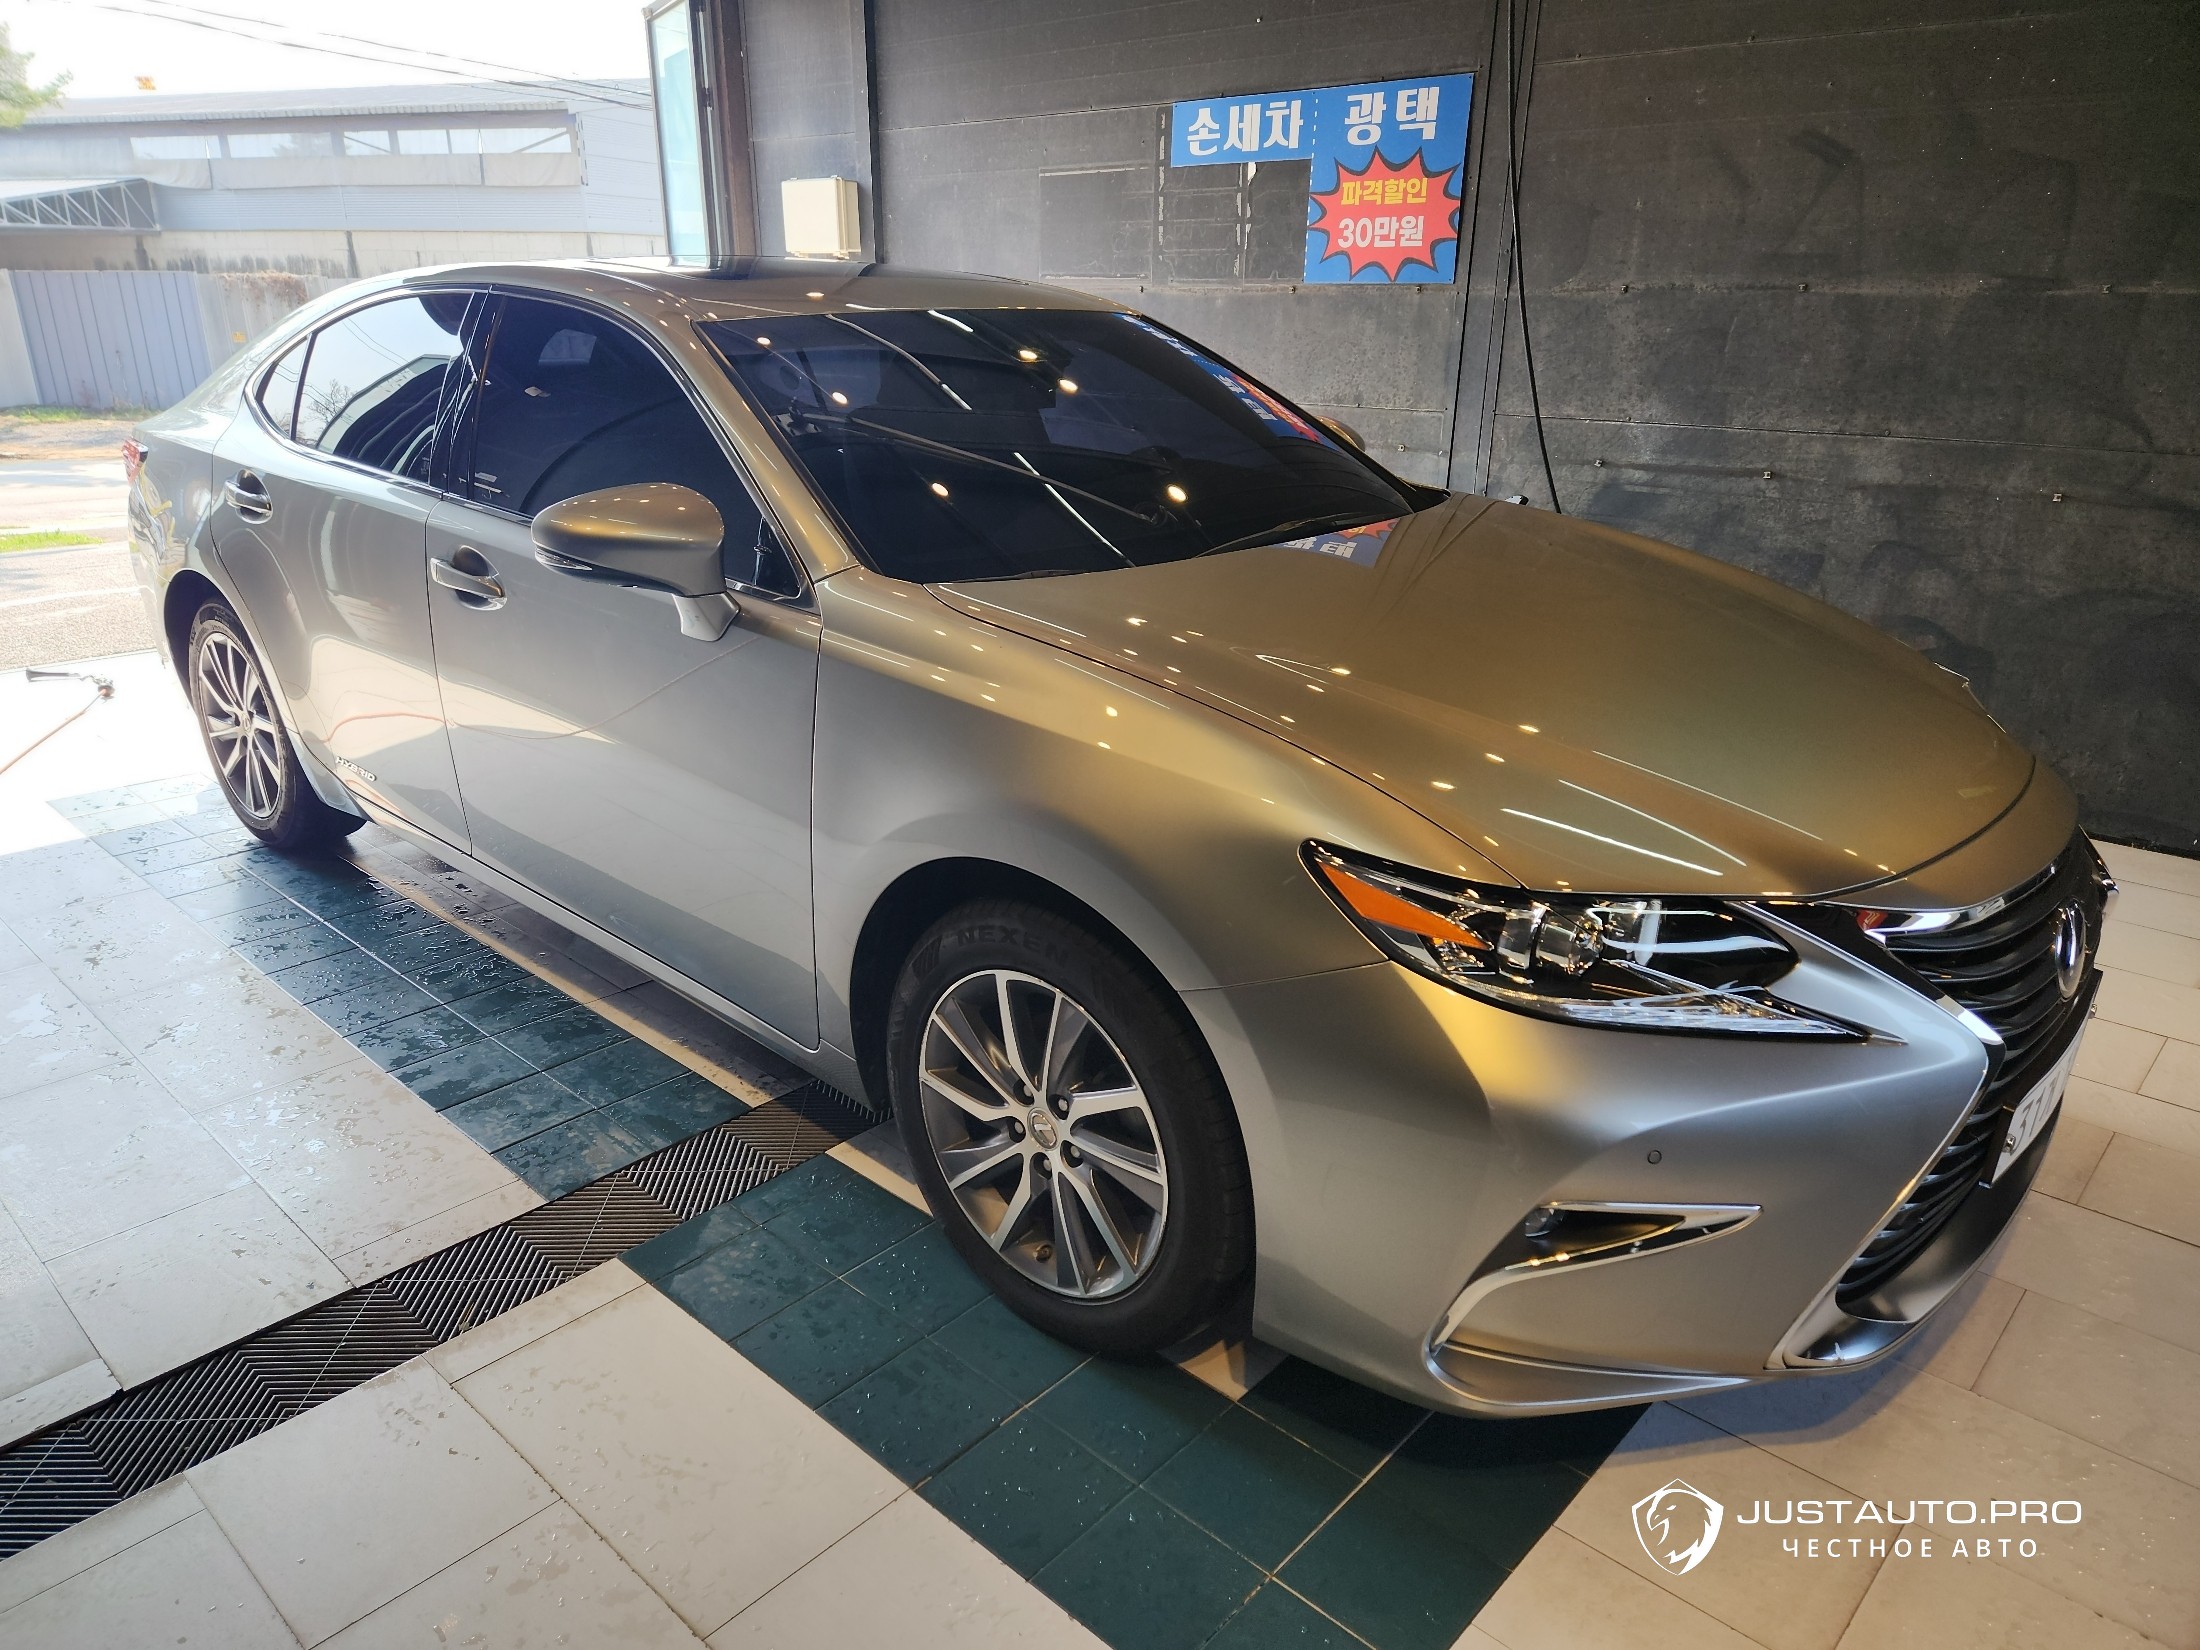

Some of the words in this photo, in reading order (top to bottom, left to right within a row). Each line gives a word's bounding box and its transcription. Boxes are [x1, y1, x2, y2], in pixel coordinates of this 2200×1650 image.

[1187, 100, 1304, 156] 손세차
[1344, 86, 1440, 146] 광택
[1341, 178, 1428, 206] 파격할인
[1337, 215, 1425, 249] 30만원
[335, 756, 377, 782] HYBRID
[956, 924, 1070, 967] NEXEN
